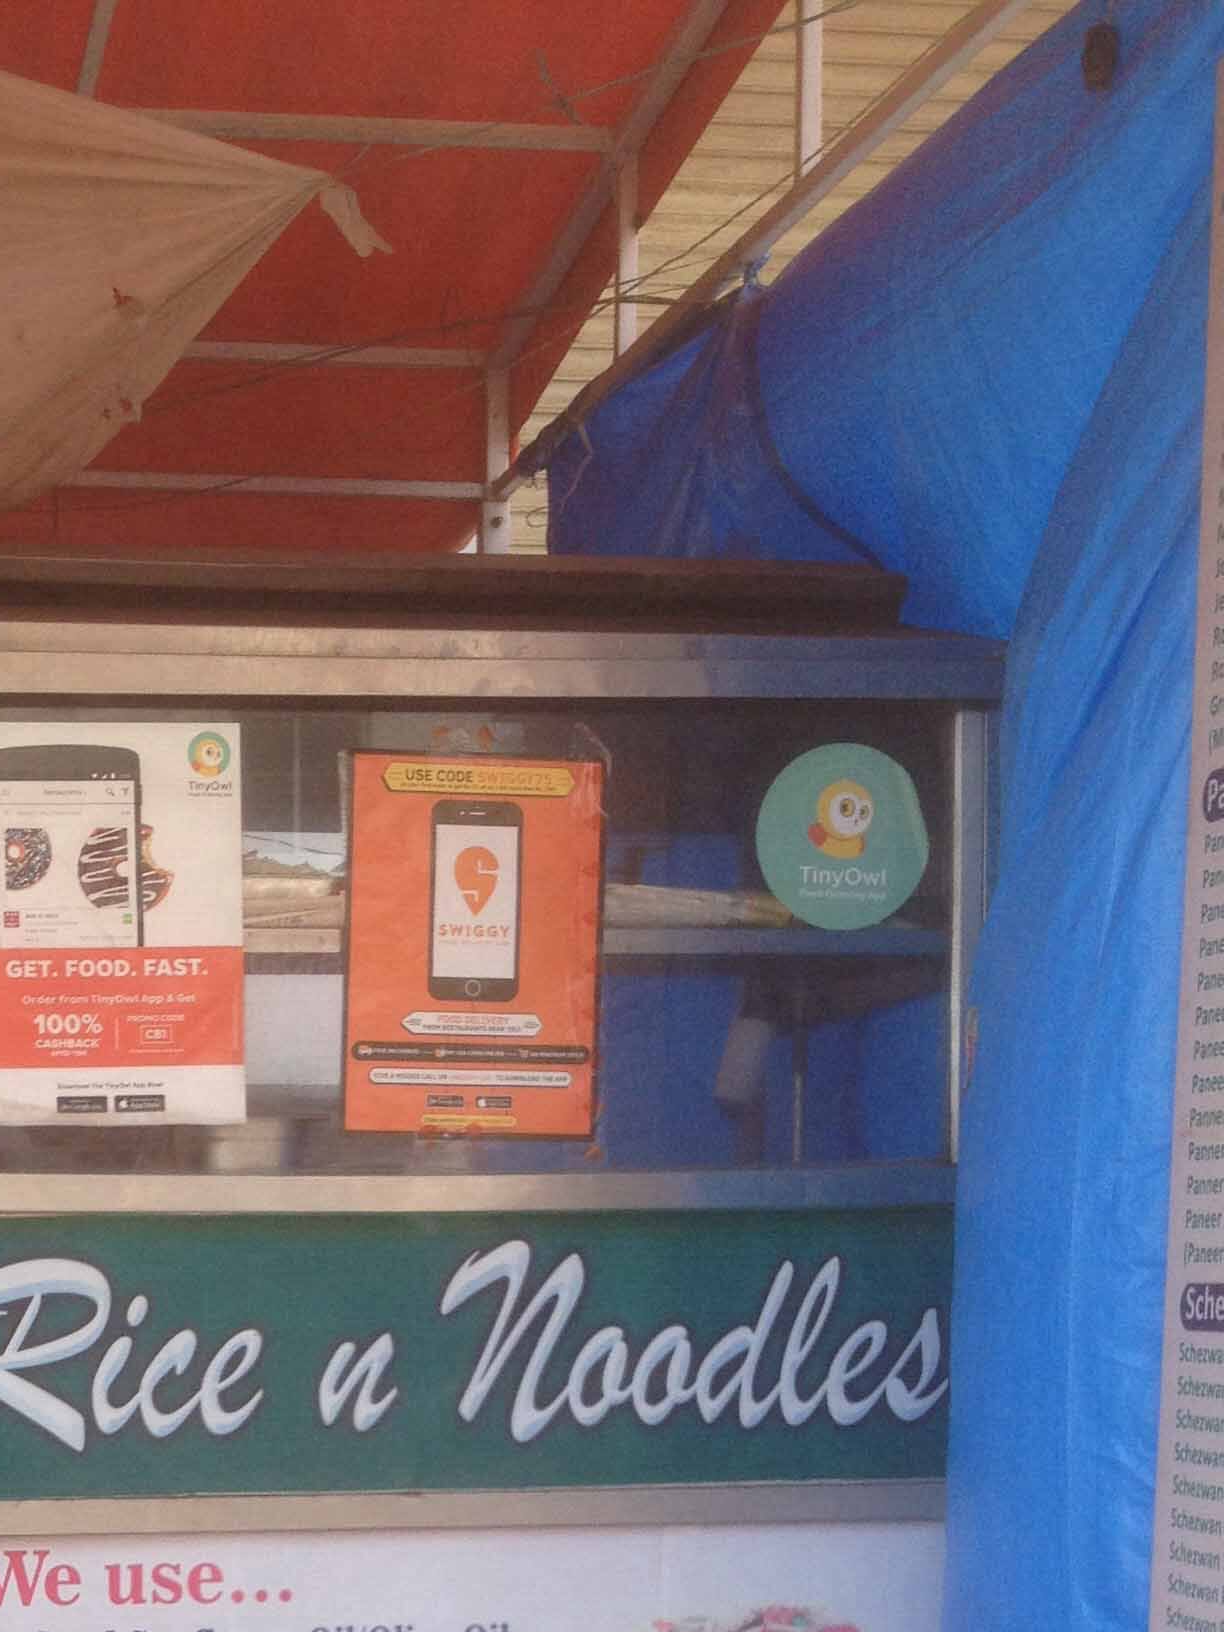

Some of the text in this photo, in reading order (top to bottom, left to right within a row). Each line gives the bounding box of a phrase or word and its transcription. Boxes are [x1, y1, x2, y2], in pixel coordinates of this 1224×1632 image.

[187, 780, 233, 793] TinyOwl
[404, 768, 433, 783] USE
[436, 769, 473, 784] CODE
[799, 865, 887, 888] TinyOwl
[438, 923, 512, 939] SWIGGY
[5, 957, 209, 978] GET. FOOD. FAST.
[22, 994, 56, 1006] Order
[58, 993, 88, 1005] from
[141, 994, 164, 1006] App
[32, 1013, 103, 1035] 100%
[35, 1037, 100, 1049] CASHBACK
[1184, 1208, 1222, 1230] Paneer
[318, 1330, 397, 1432] n
[441, 1240, 949, 1444] Noodles
[1173, 1473, 1224, 1501] Schezwan
[1171, 1506, 1223, 1536] Schezwan
[1169, 1539, 1221, 1571] Schezwan
[104, 1559, 295, 1607] use...
[1167, 1573, 1219, 1604] Schezwan
